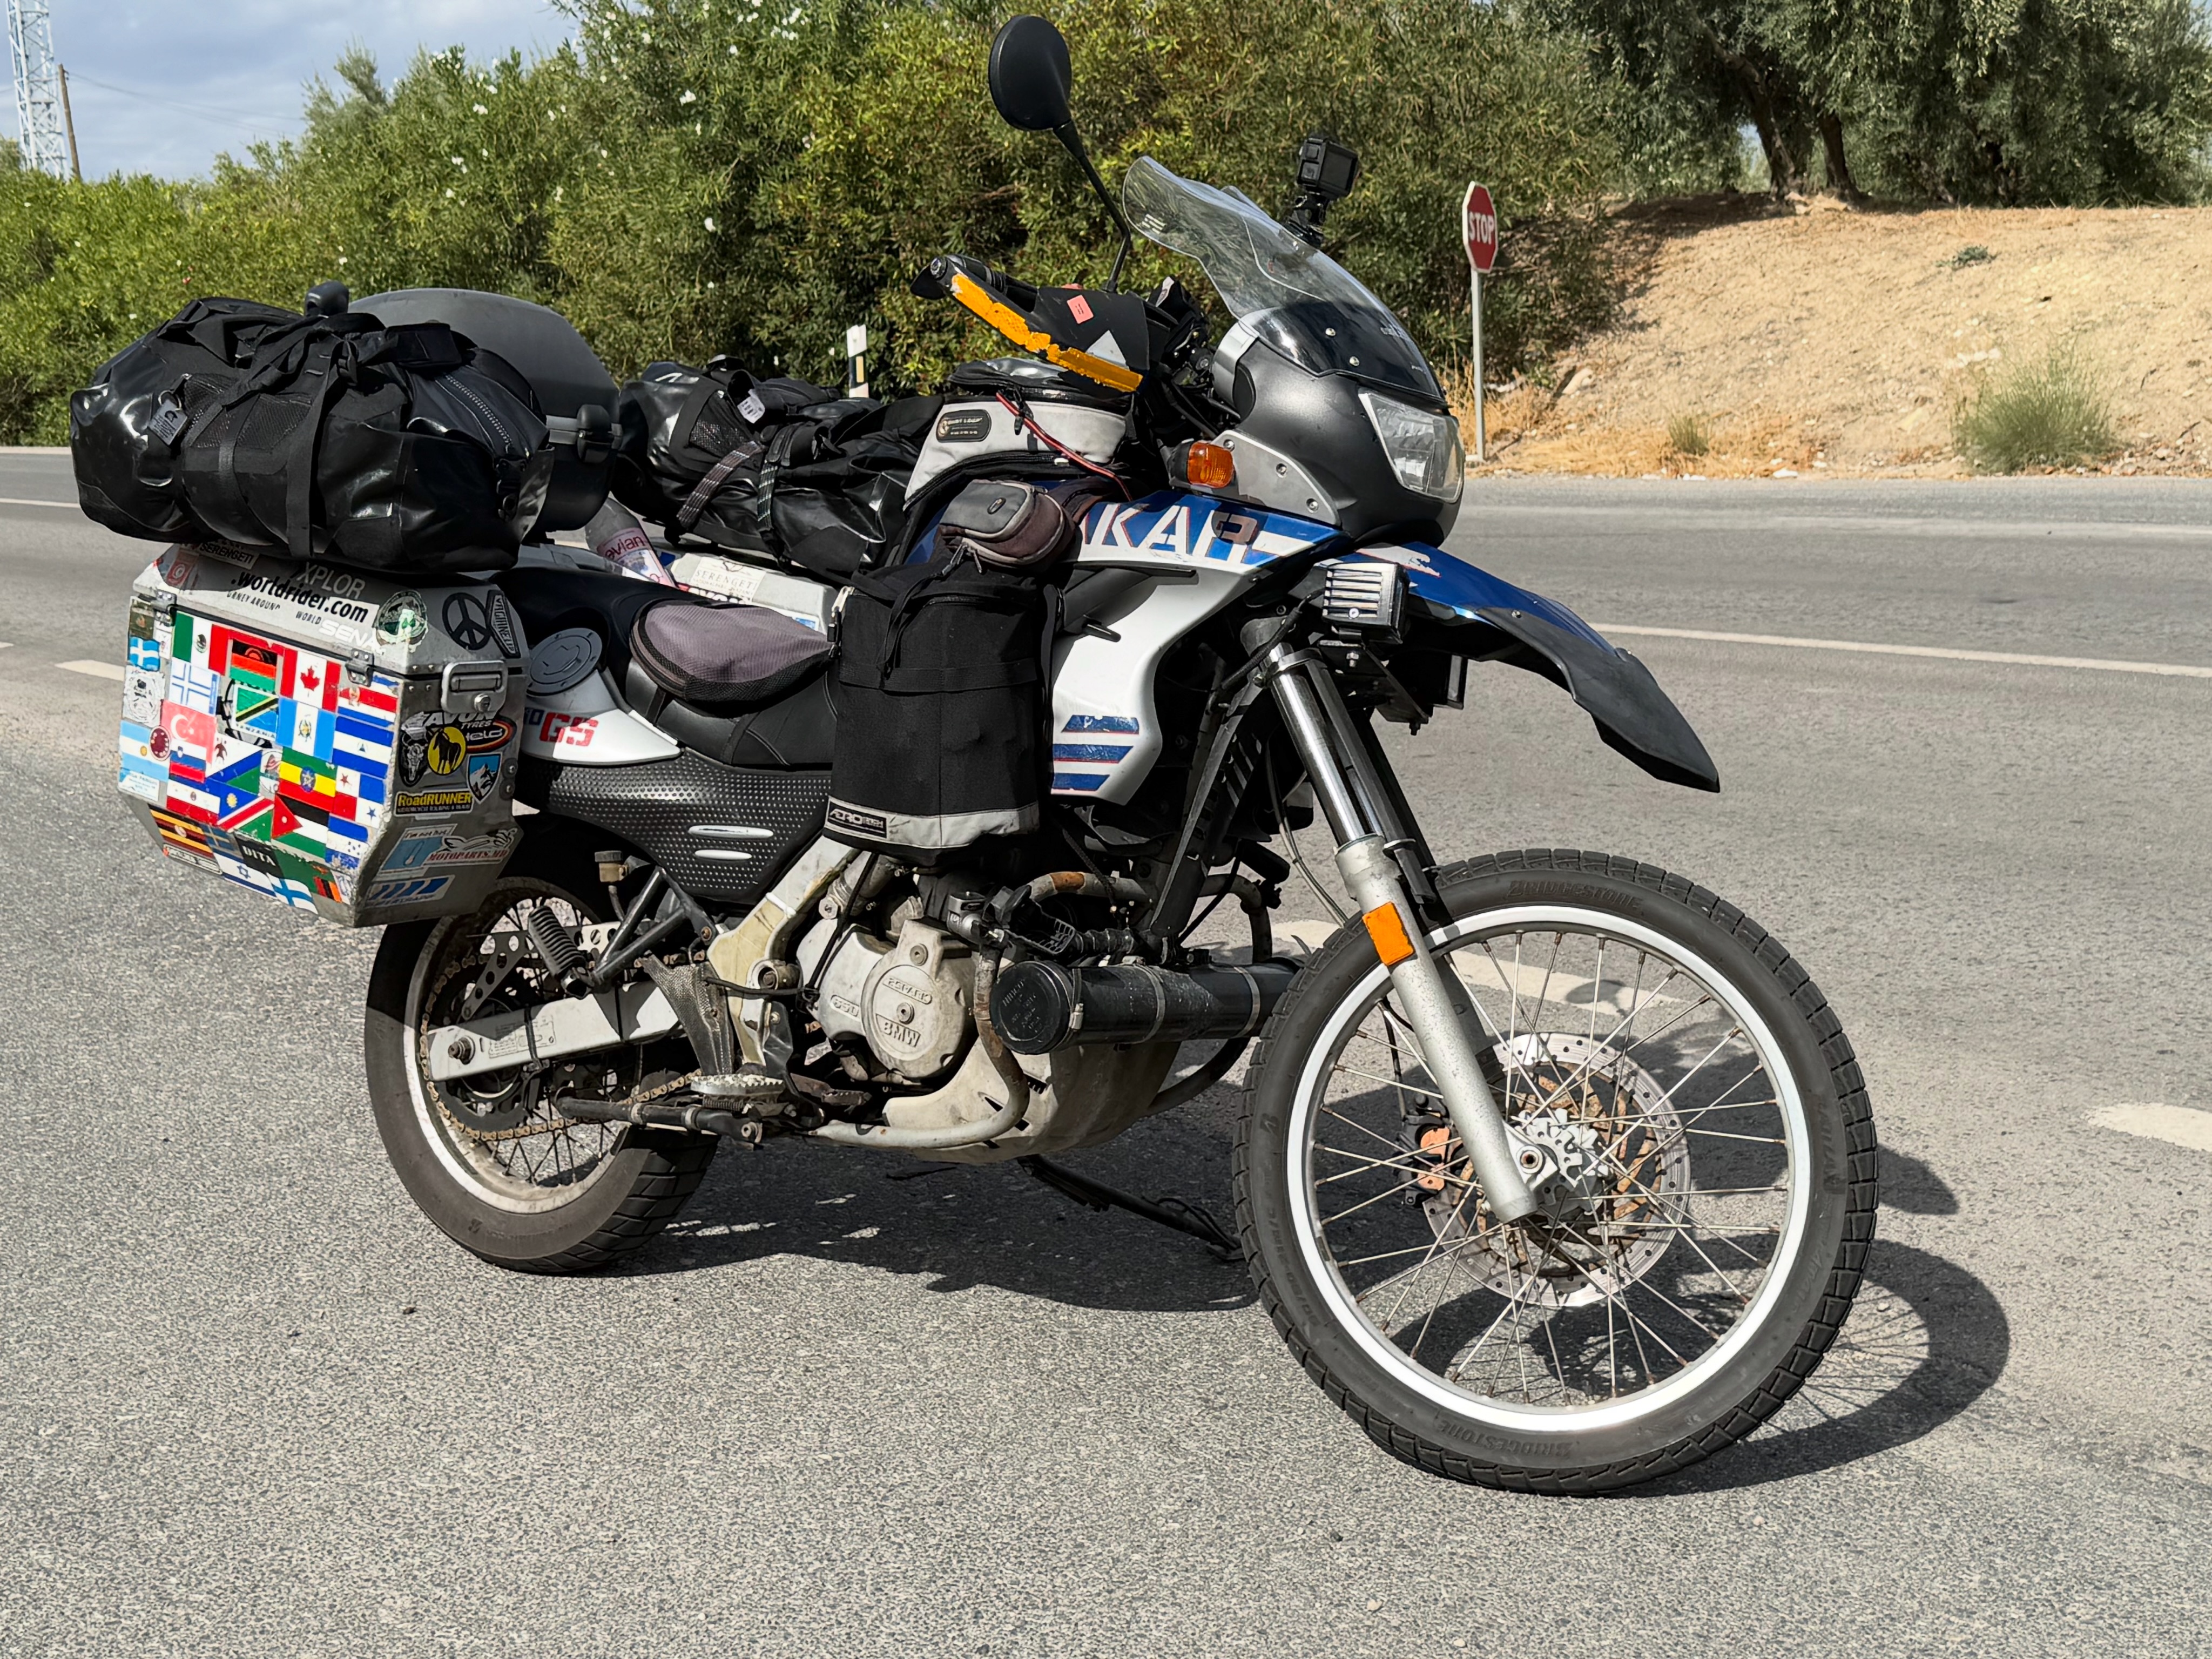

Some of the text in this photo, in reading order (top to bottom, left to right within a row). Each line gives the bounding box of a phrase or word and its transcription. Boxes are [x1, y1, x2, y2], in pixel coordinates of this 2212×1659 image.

[1468, 211, 1495, 245] STOP
[1080, 503, 1260, 563] KAR
[199, 542, 254, 564] SERENGETI
[604, 536, 645, 560] evian
[295, 611, 322, 625] WORLD
[460, 720, 493, 730] TYRES
[539, 711, 599, 747] GS
[397, 791, 473, 807] RoadRUNNER
[1507, 880, 1643, 909] BRIDGESTONE
[883, 1021, 921, 1047] BMW
[1437, 1420, 1573, 1456] BRIDGESTONE
